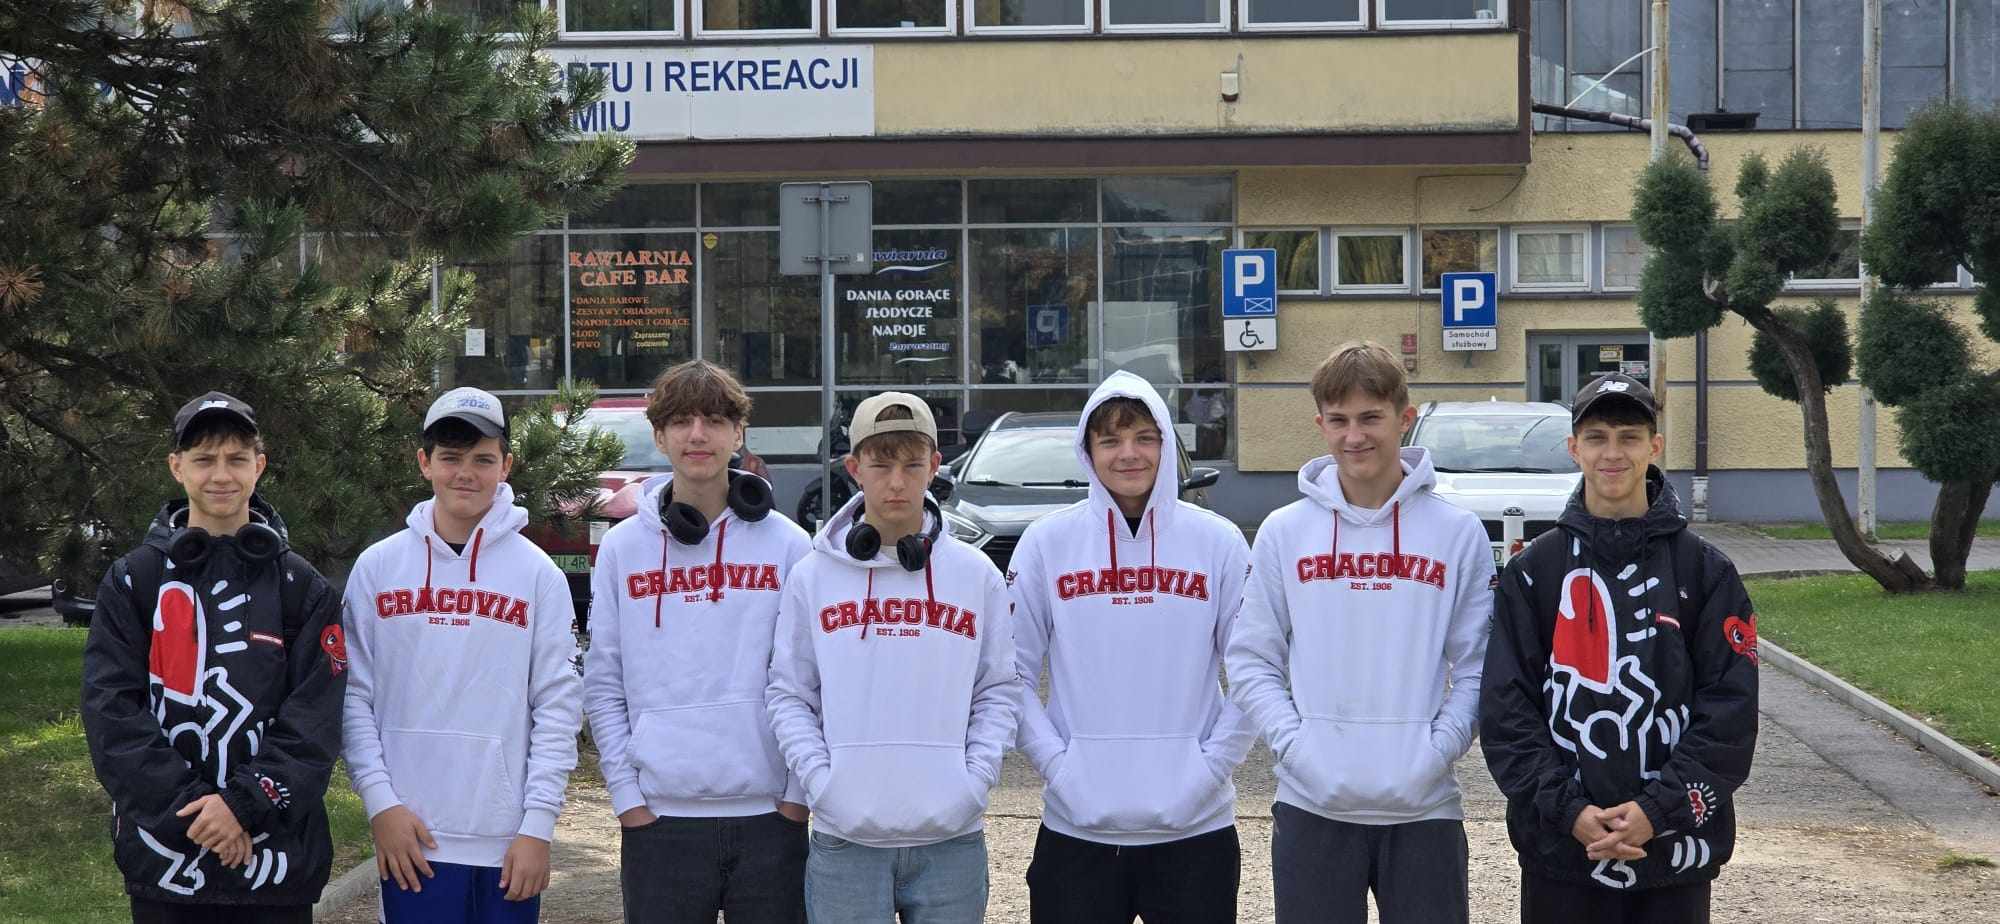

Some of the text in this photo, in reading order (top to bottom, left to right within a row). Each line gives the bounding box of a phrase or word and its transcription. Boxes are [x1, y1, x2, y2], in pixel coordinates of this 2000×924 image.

[549, 57, 858, 92] RTU I REKREACJI
[569, 250, 693, 267] KAWIARNIA
[581, 268, 689, 286] CAFE BAR
[1235, 256, 1265, 297] P
[576, 296, 607, 305] DANIA
[846, 289, 951, 303] DANIA GORĄCE
[1453, 280, 1485, 321] P
[576, 307, 618, 316] ZESTAWY
[865, 306, 933, 319] SŁODYCZE
[576, 330, 600, 338] LODY
[872, 324, 927, 338] NAPOJE
[576, 341, 600, 349] PIWO
[1297, 552, 1447, 592] CRACOVIA
[627, 562, 780, 599] CRACOVIA
[1056, 566, 1209, 601] CRACOVIA
[1350, 582, 1392, 591] EST. 1906
[684, 593, 702, 603] EST.
[1112, 597, 1131, 605] EST.
[376, 587, 529, 630] CRACOVIA
[428, 616, 449, 626] EST.
[820, 598, 977, 640] CRACOVIA
[876, 628, 921, 637] EST. 1906
